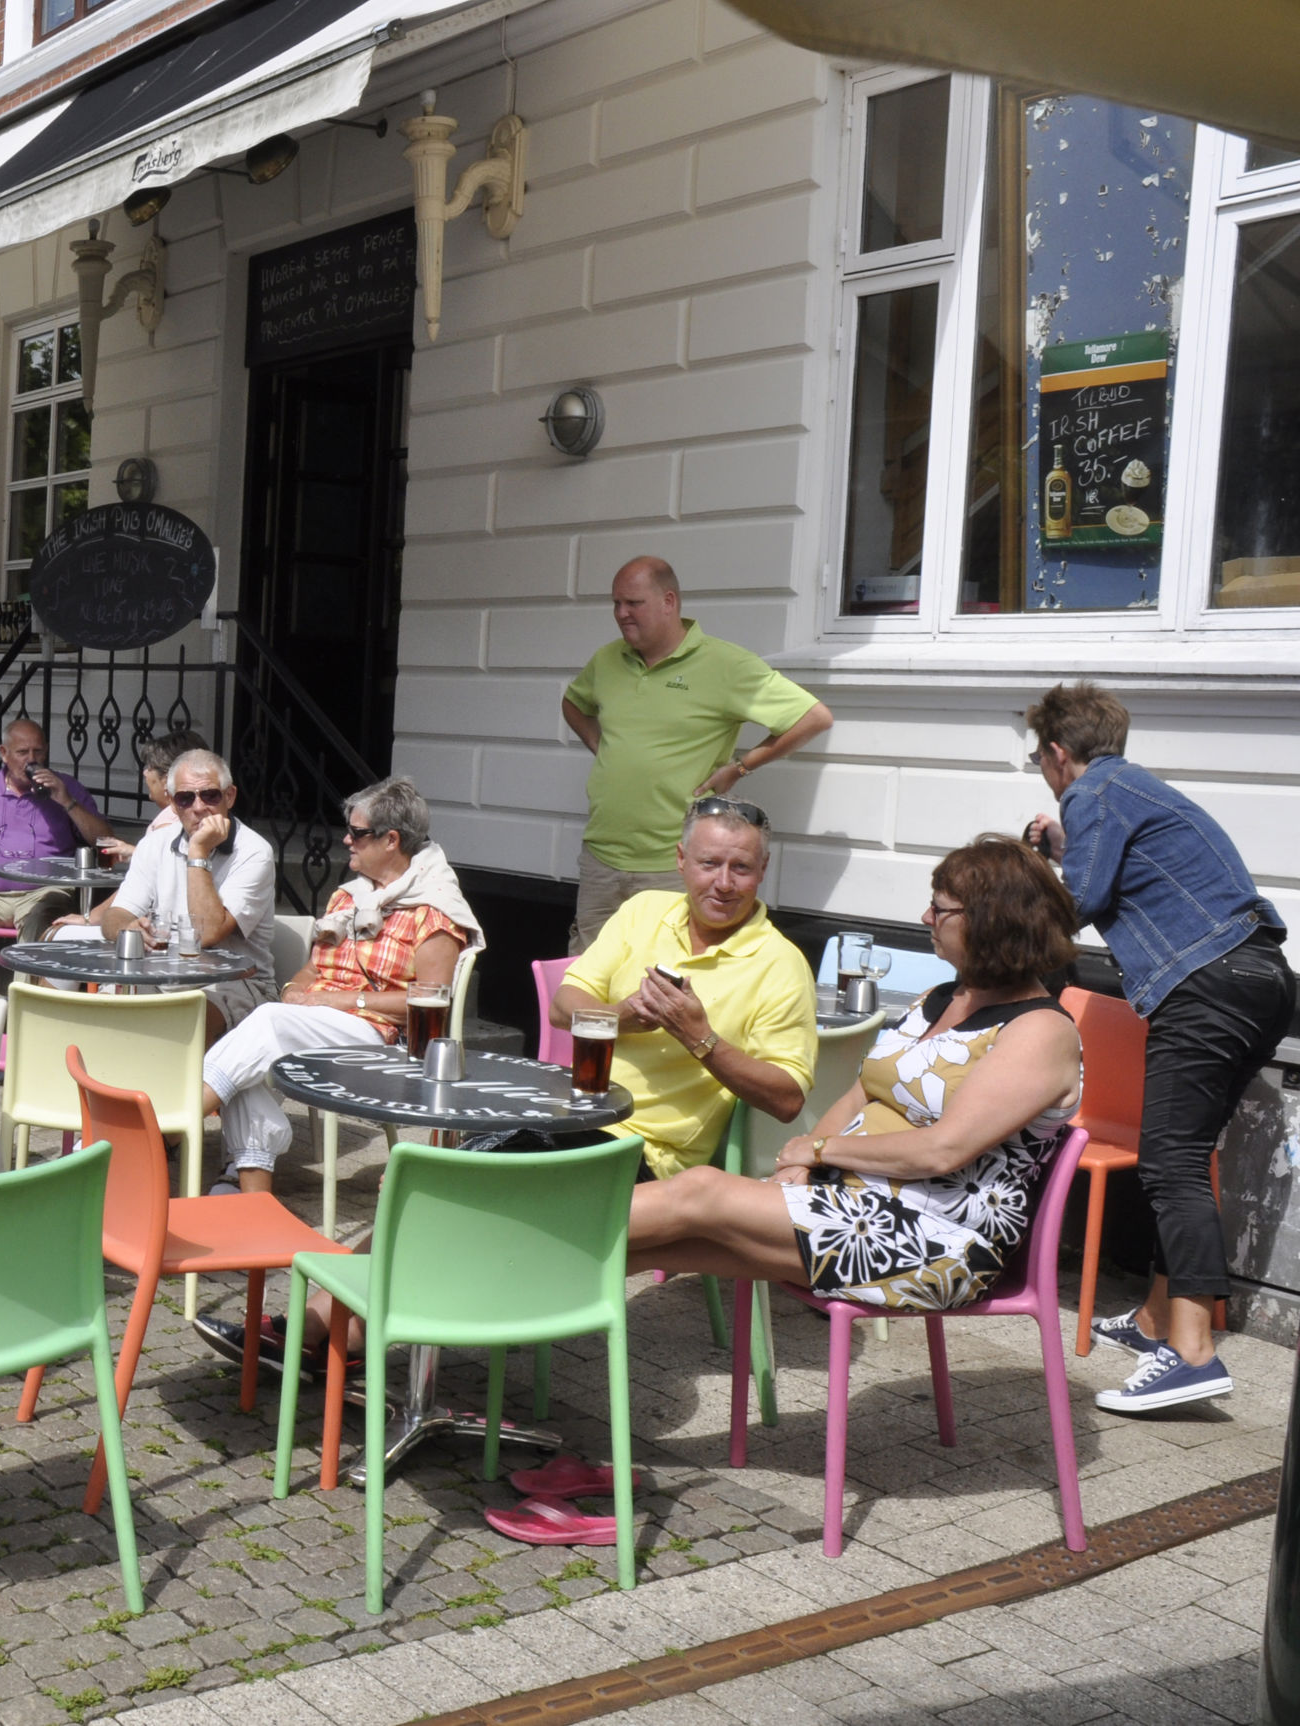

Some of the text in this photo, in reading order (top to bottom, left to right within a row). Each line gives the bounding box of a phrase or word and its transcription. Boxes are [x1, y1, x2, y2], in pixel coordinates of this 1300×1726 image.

[363, 226, 405, 254] PENGE
[334, 271, 350, 285] DU
[260, 307, 317, 343] PROCENTER
[323, 293, 339, 318] PÅ
[1074, 417, 1153, 456] COFFEE
[39, 527, 69, 559] THE
[110, 505, 140, 533] PUB
[477, 1052, 563, 1072] Irish
[302, 1082, 518, 1117] Denmark
